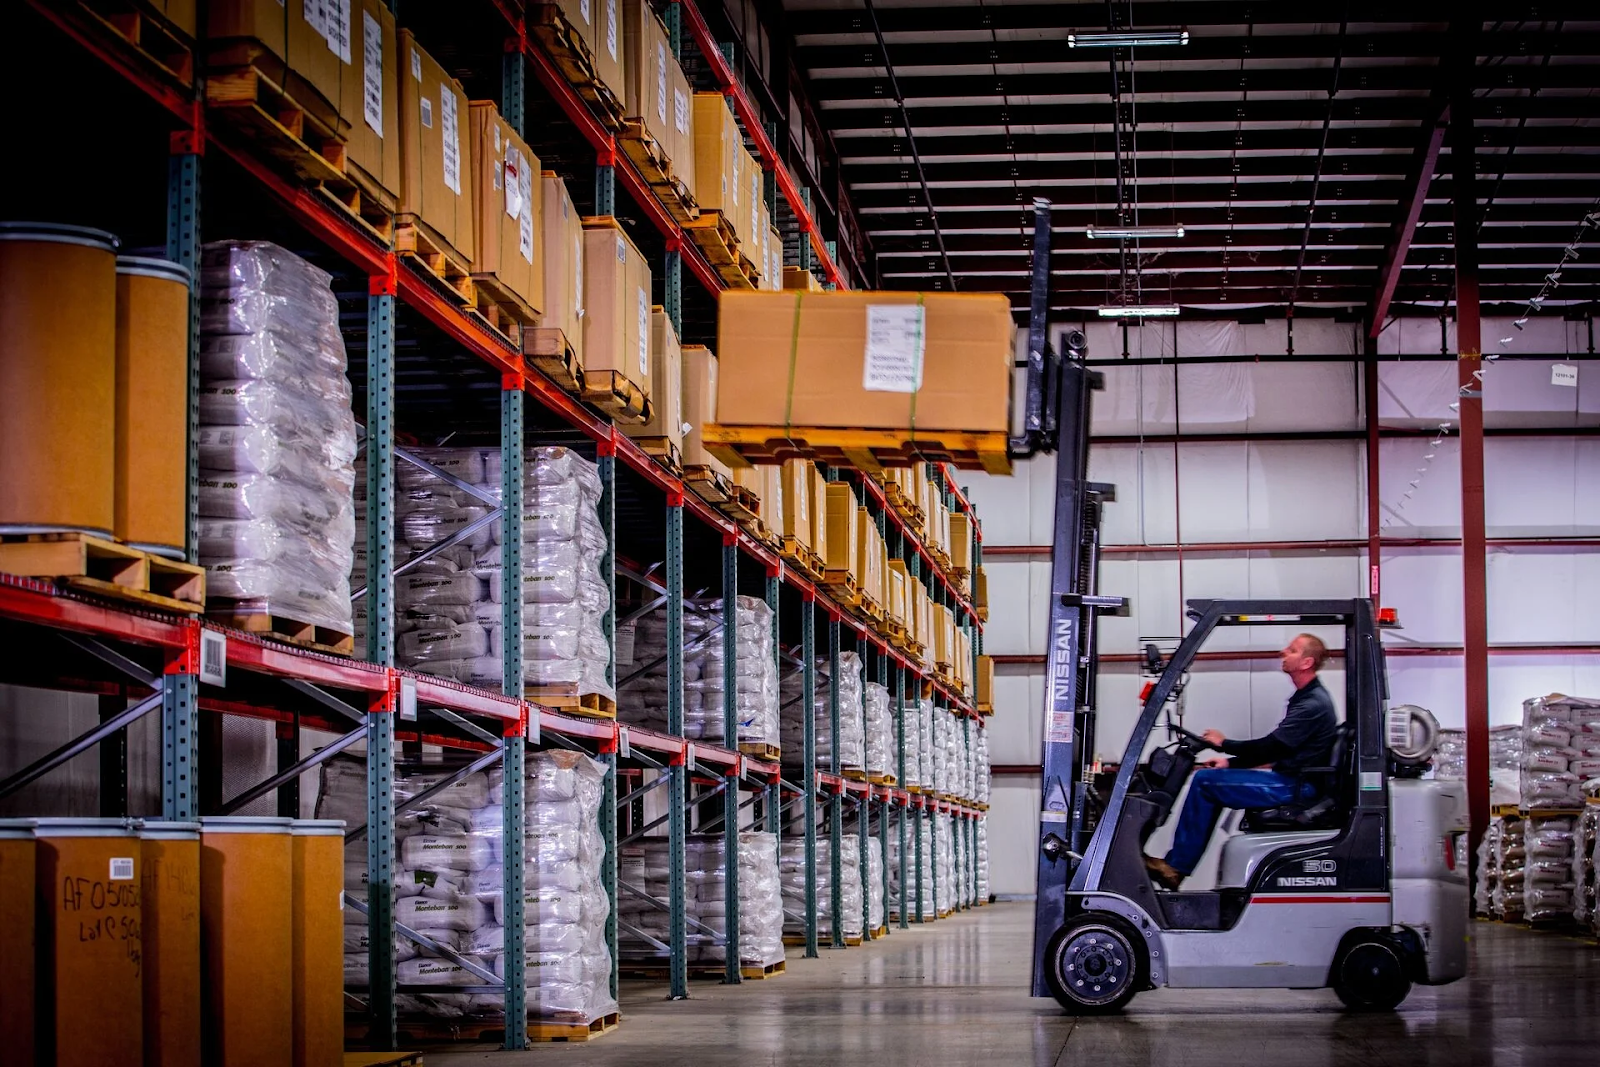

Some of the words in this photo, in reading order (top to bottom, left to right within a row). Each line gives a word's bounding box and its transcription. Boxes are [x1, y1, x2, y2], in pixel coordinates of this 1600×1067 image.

[1055, 619, 1072, 700] NISSAN
[1277, 877, 1337, 887] NISSAN
[415, 904, 445, 912] Monteban
[418, 966, 450, 975] Monteban
